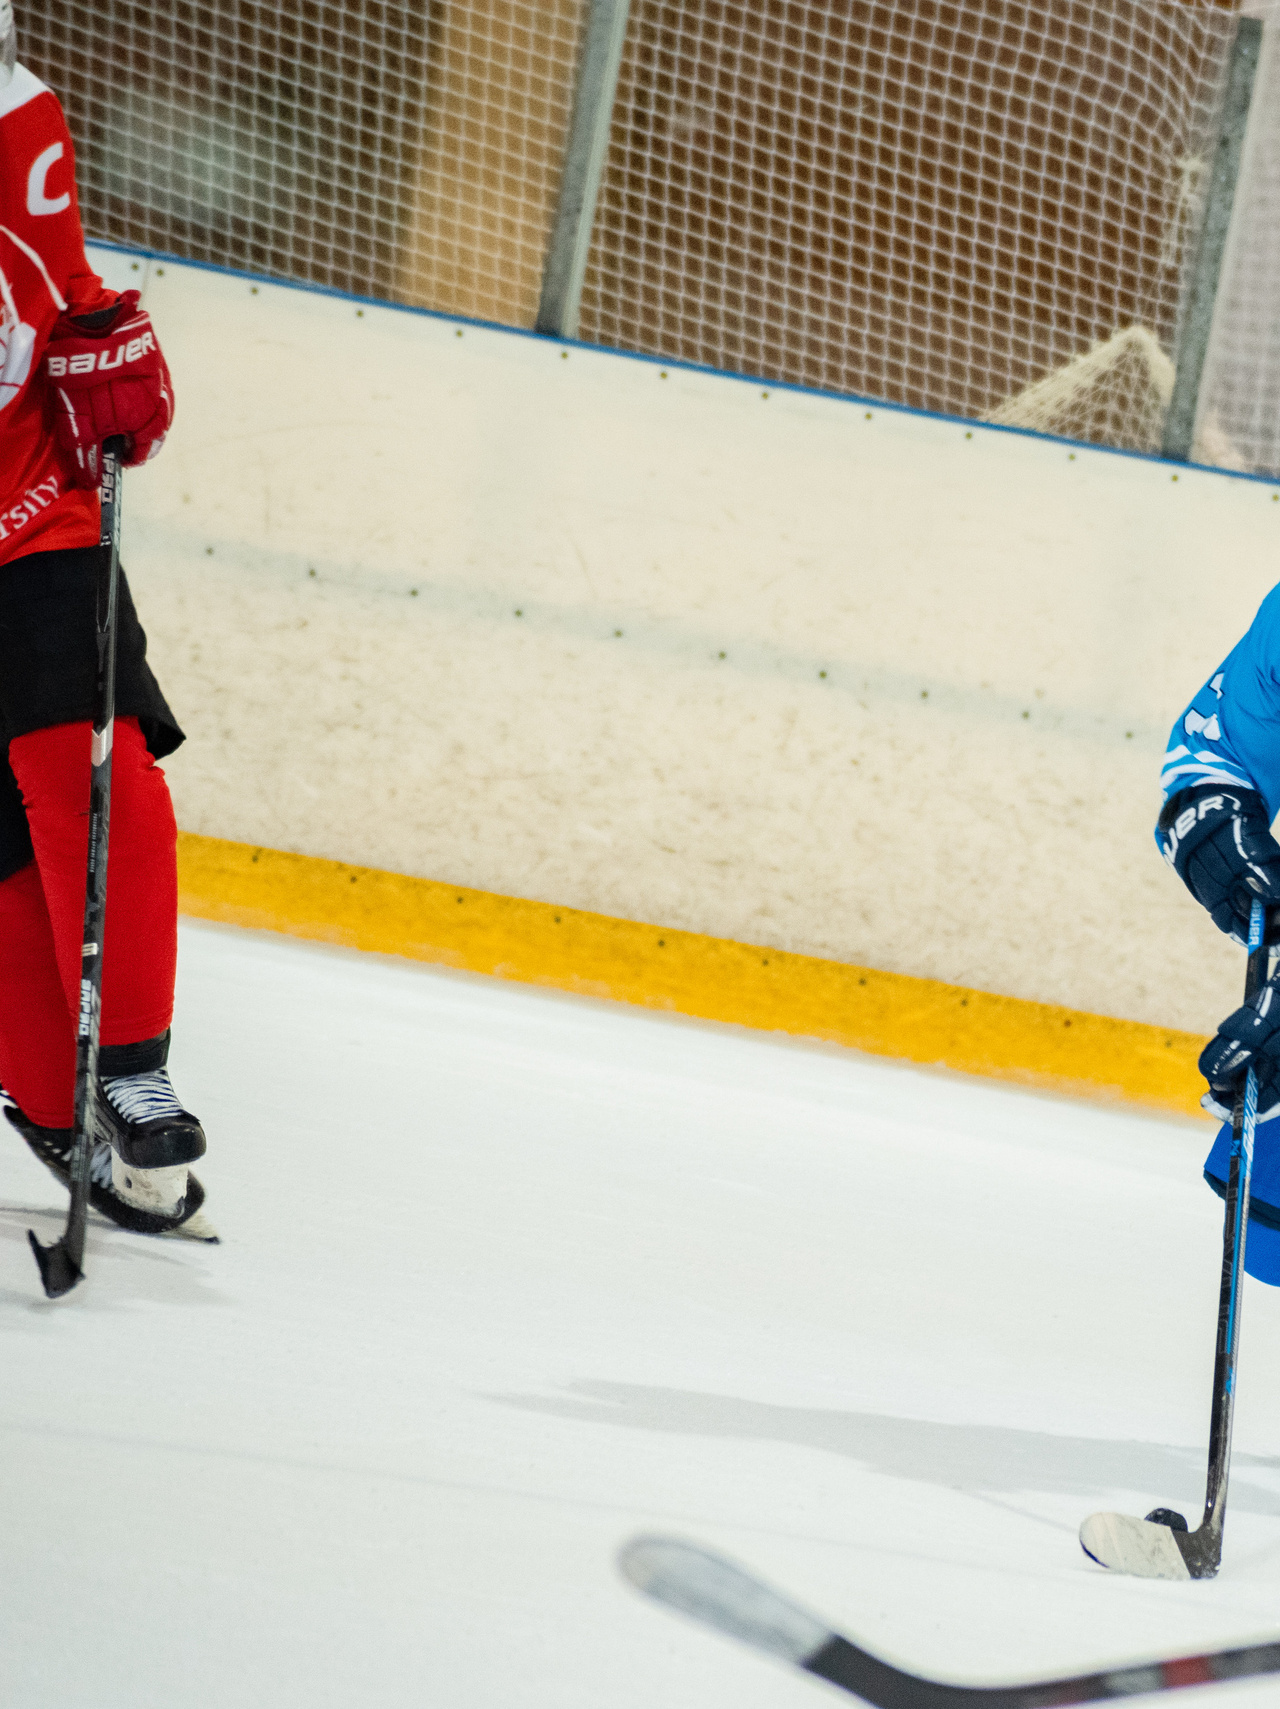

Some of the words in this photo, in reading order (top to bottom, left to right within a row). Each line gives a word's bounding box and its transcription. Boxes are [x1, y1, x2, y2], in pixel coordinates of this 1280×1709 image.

[27, 142, 71, 217] C
[47, 330, 158, 378] BAUER
[1162, 795, 1225, 866] UER
